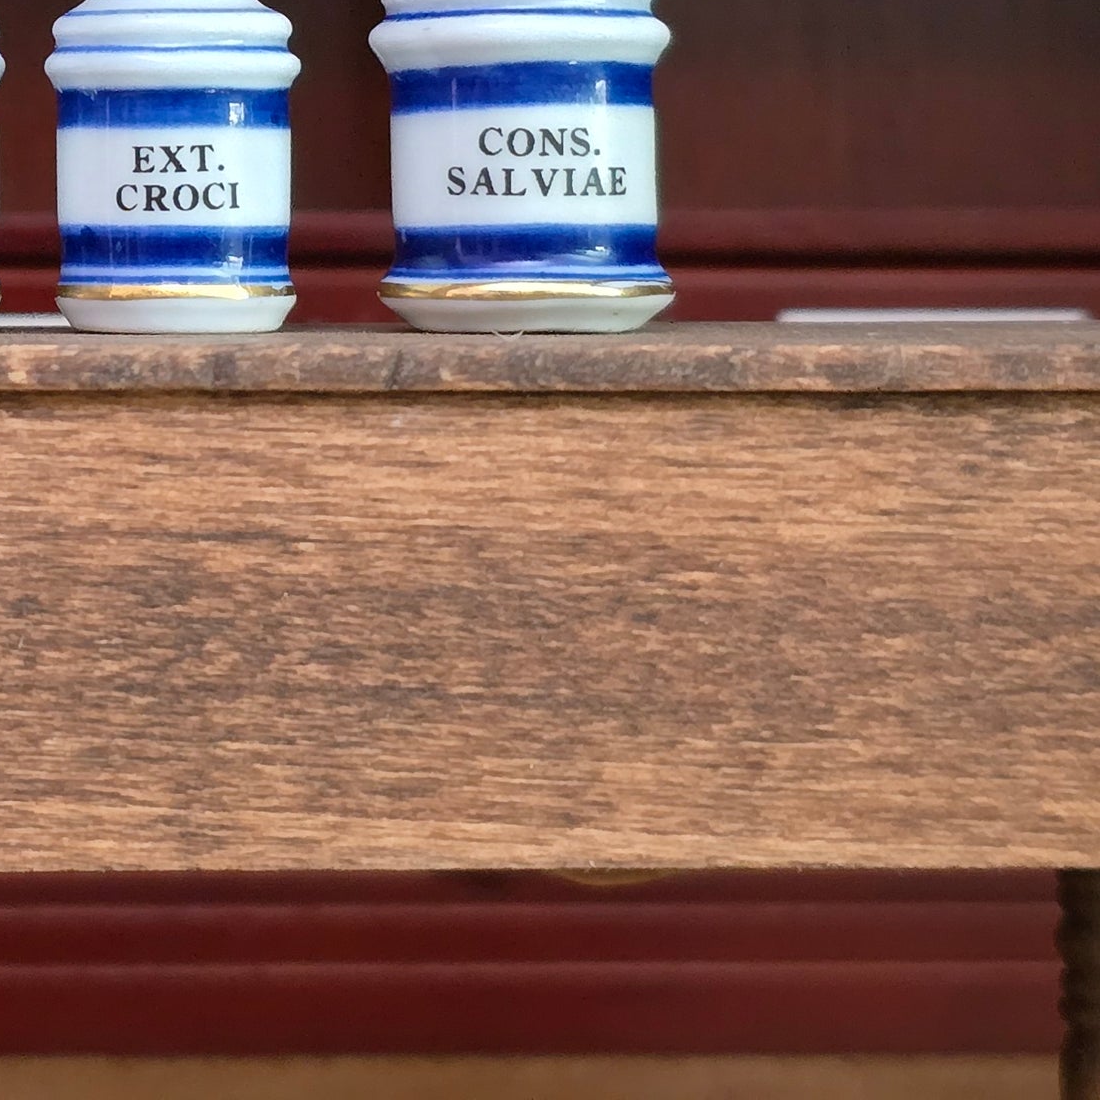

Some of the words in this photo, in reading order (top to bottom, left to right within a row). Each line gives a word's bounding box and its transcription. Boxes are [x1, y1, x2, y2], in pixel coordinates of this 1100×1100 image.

[478, 126, 600, 157] CONS.
[132, 144, 225, 174] EXT.
[446, 166, 627, 197] SALVIAE
[115, 182, 240, 212] CROCI
